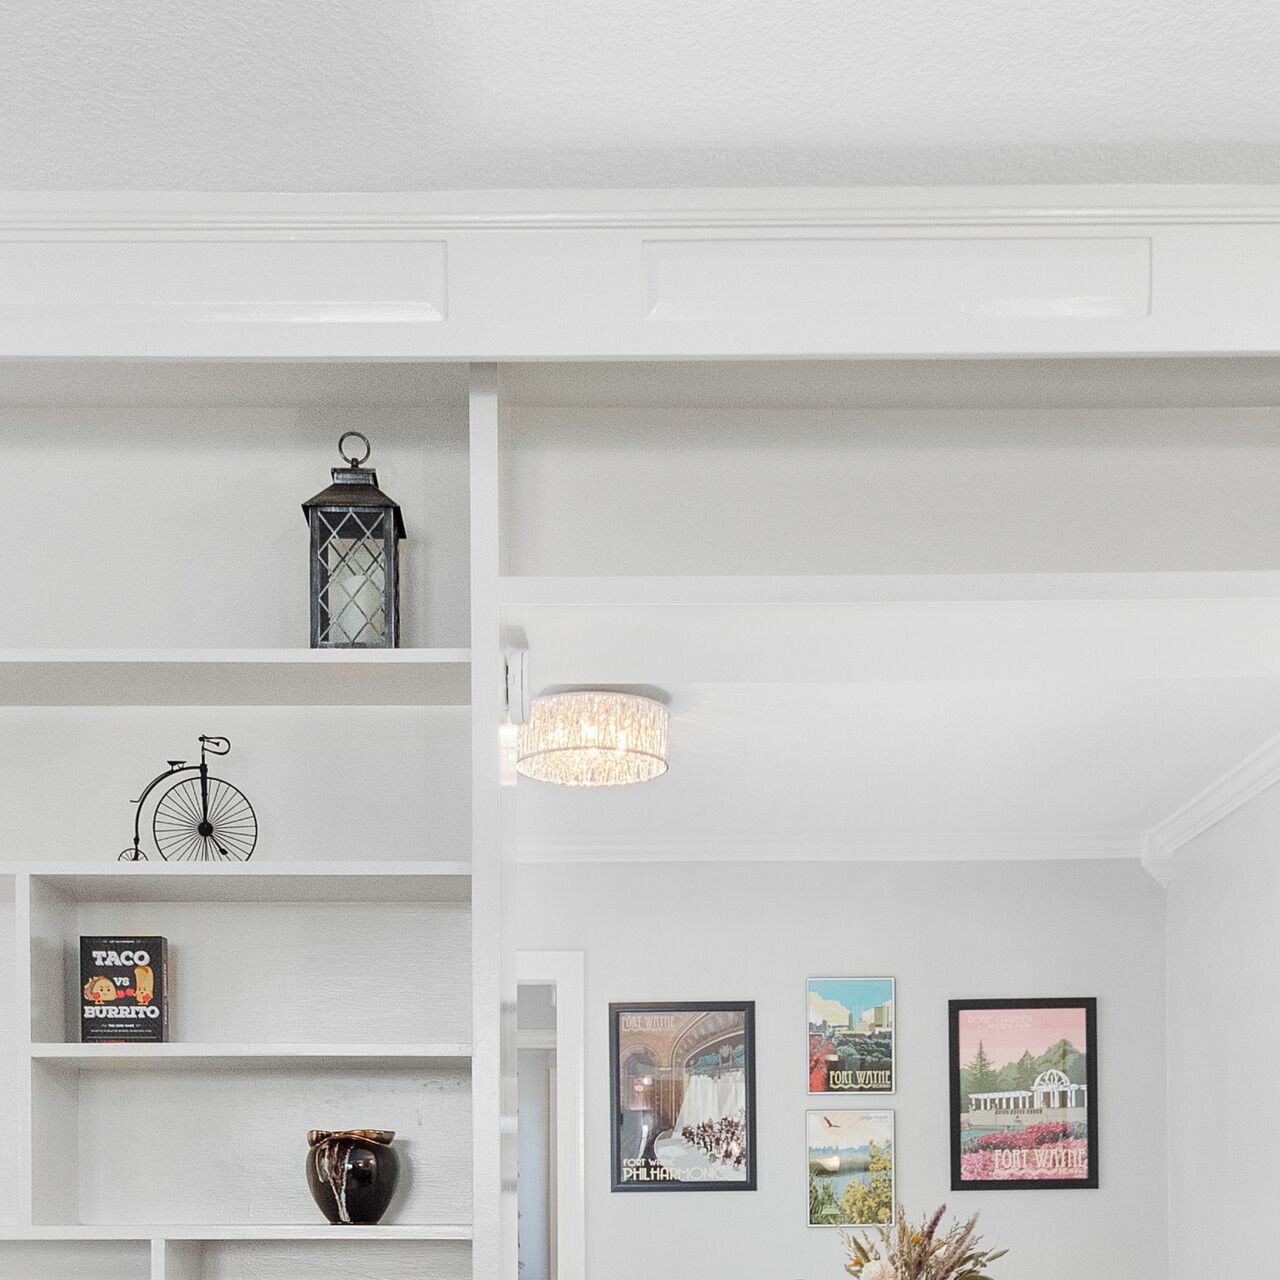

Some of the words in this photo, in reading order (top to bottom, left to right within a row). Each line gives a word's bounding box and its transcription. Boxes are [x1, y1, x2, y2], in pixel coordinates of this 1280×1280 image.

[92, 950, 150, 966] TACO
[113, 977, 130, 986] VS
[83, 1005, 160, 1019] BURRITO
[830, 1070, 853, 1084] FORT
[856, 1070, 891, 1084] WAYNE
[623, 1158, 646, 1166] FORT
[994, 1149, 1029, 1169] FORT
[1034, 1148, 1085, 1169] WAYNE
